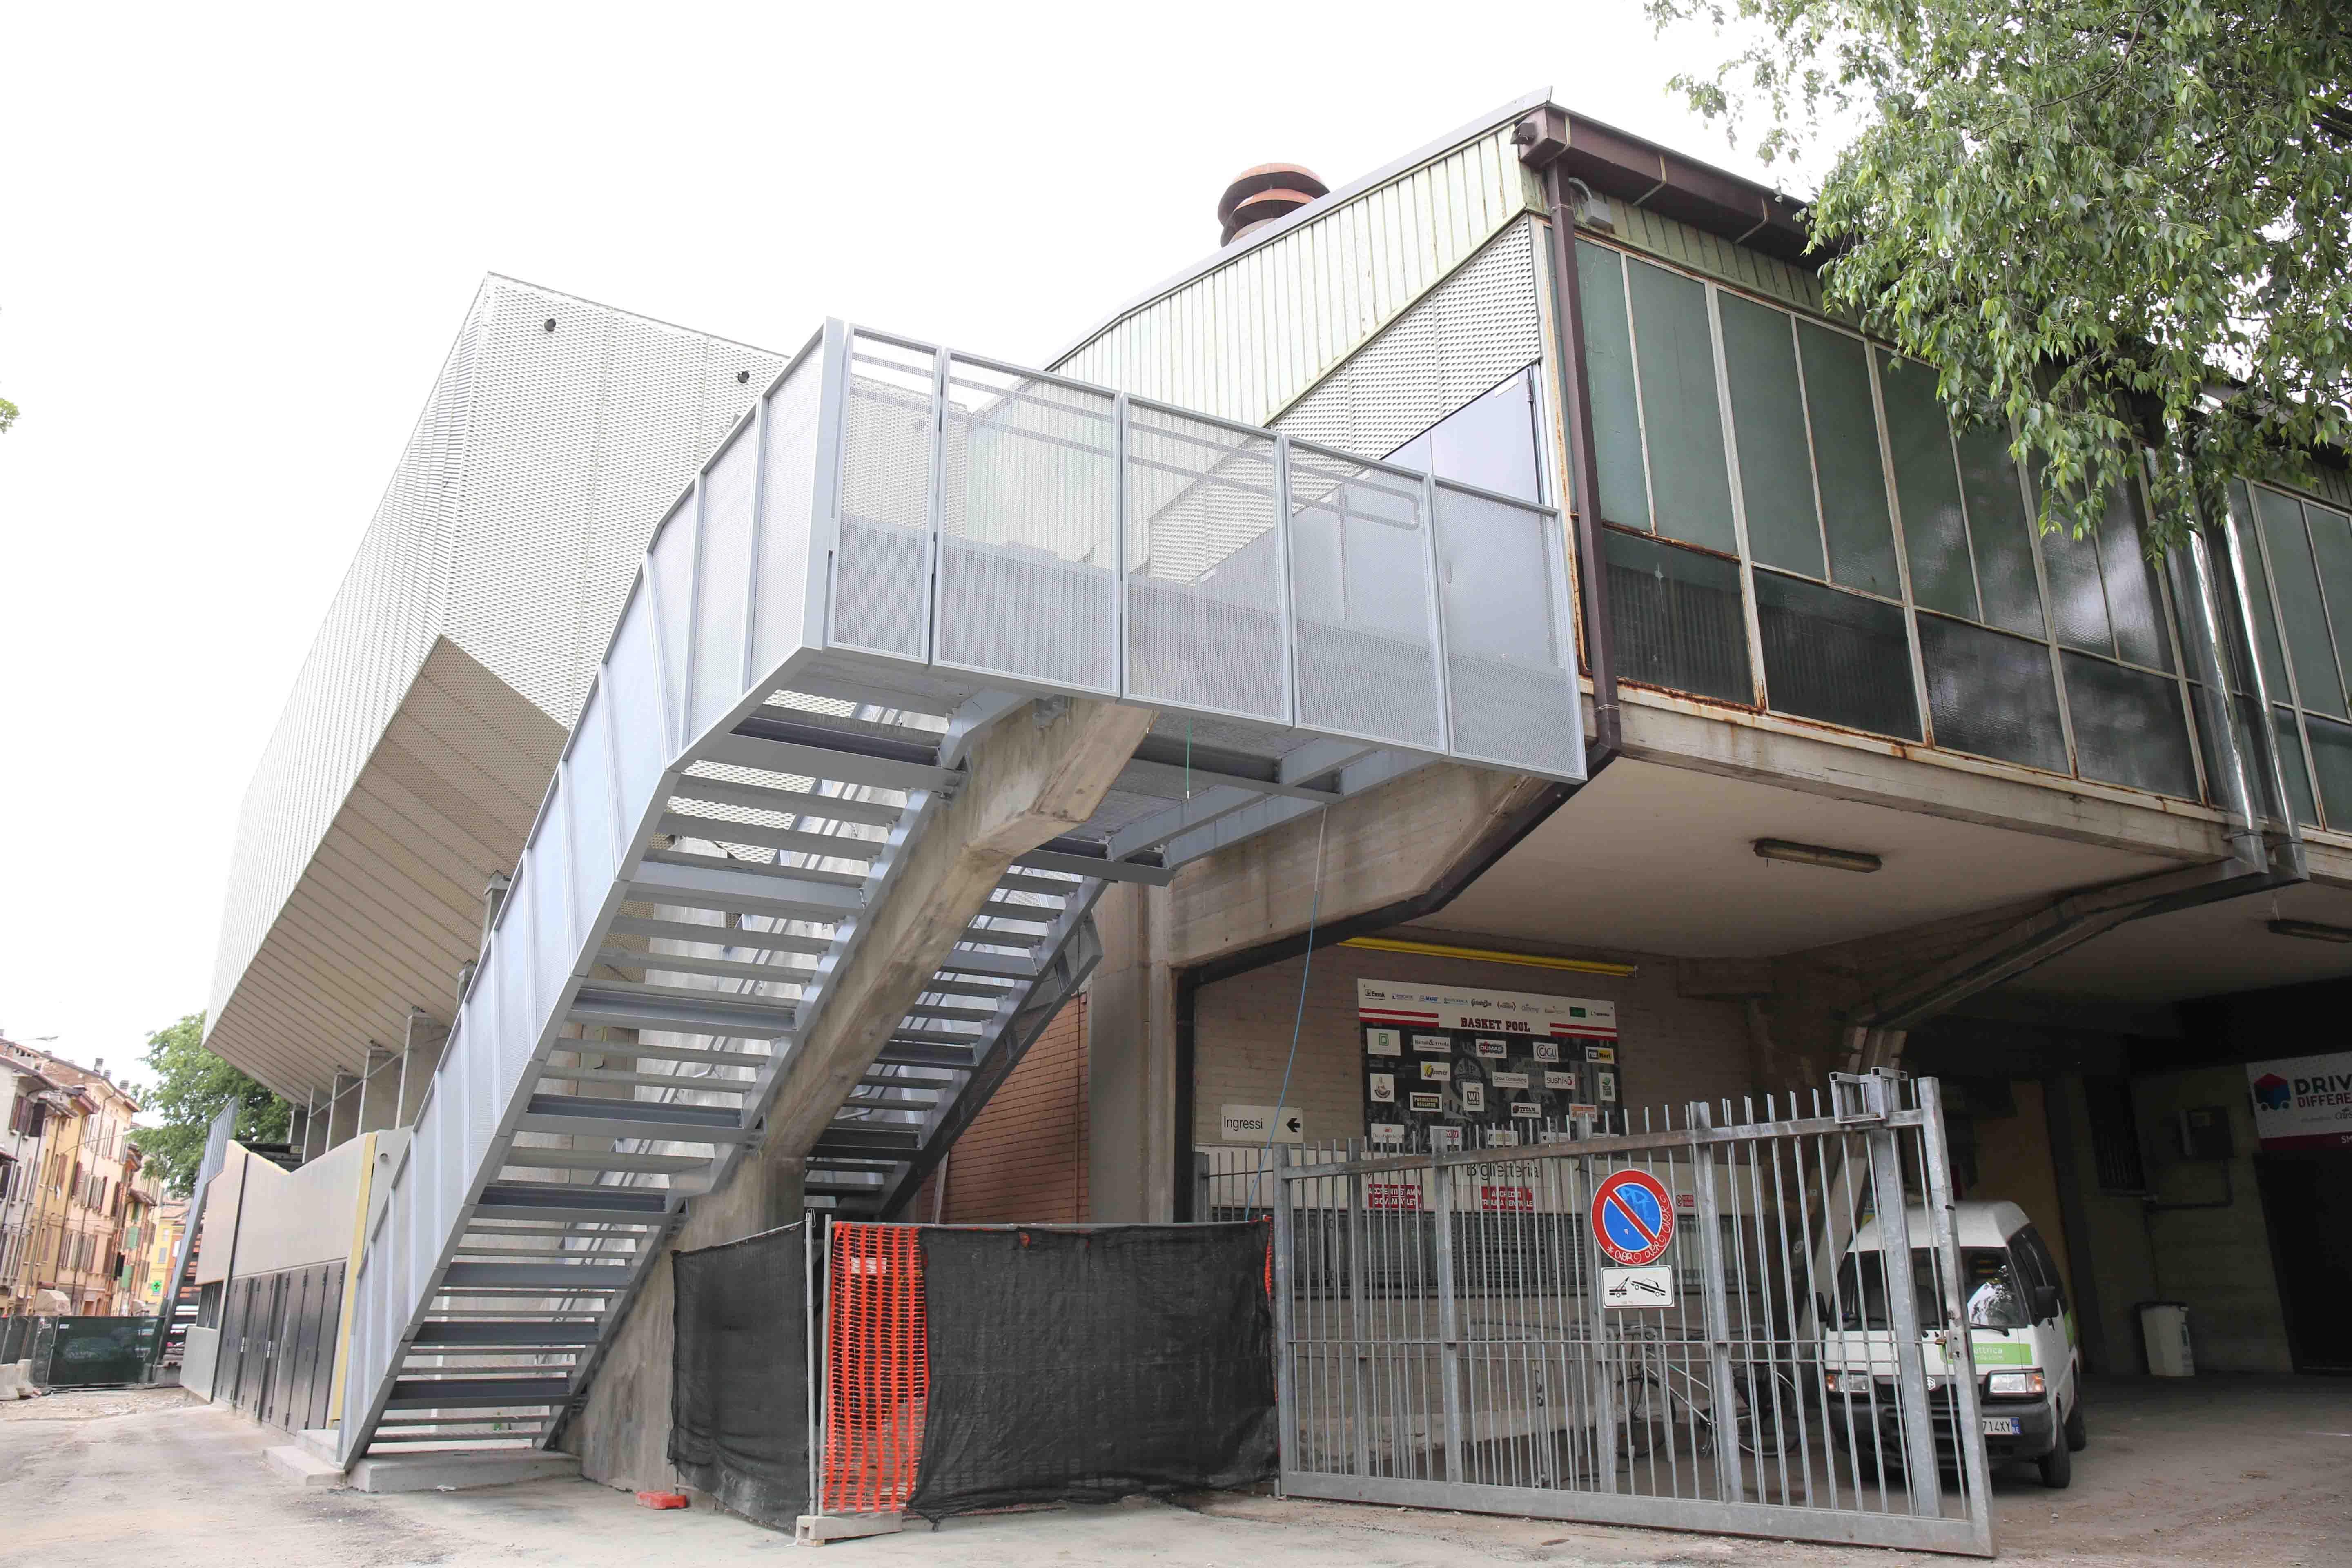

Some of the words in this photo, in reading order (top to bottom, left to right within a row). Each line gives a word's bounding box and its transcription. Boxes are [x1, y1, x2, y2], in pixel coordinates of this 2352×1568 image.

[1460, 1017, 1502, 1030] BASKET
[1506, 1020, 1530, 1033] POOL
[1224, 1116, 1263, 1131] Ingressi
